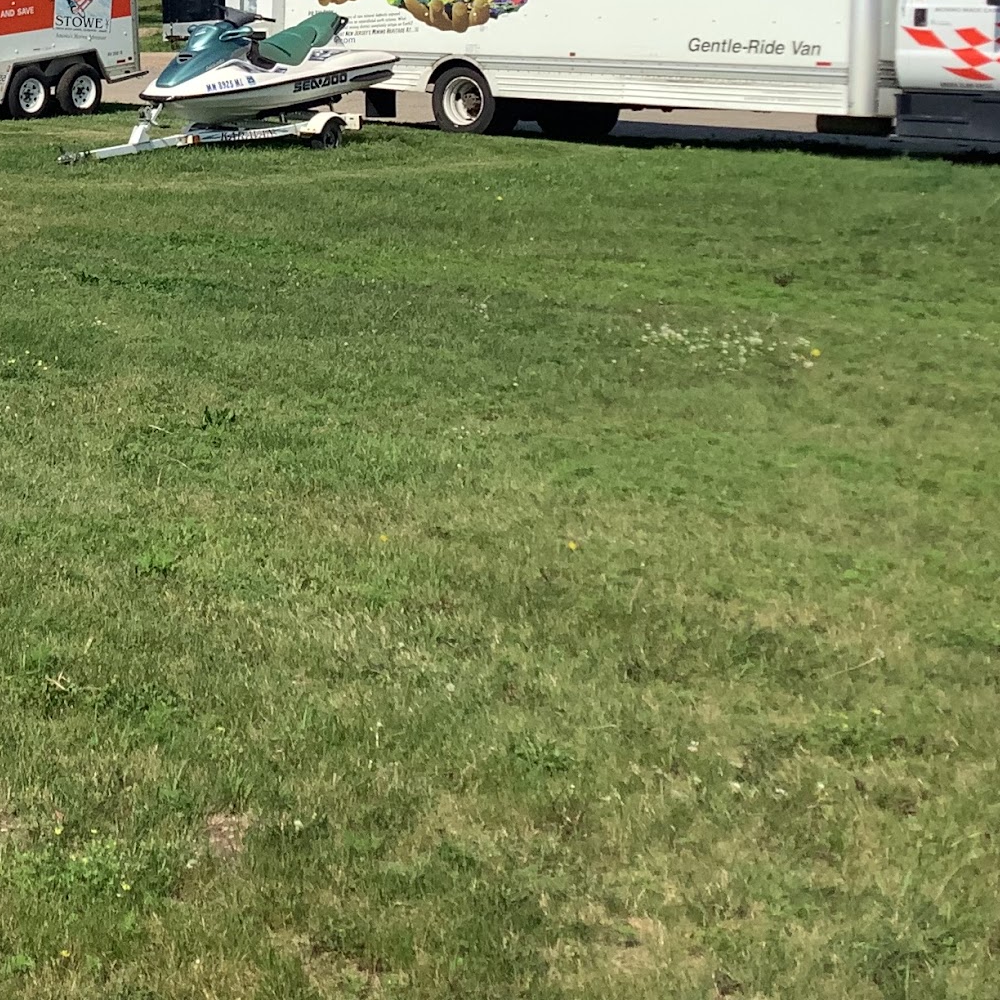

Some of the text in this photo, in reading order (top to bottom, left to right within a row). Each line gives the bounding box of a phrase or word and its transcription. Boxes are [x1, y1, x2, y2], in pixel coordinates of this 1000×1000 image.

[0, 9, 16, 18] AND
[17, 6, 35, 16] SAVE
[55, 14, 104, 29] STOWE
[688, 37, 822, 56] Gentle-Ride Van
